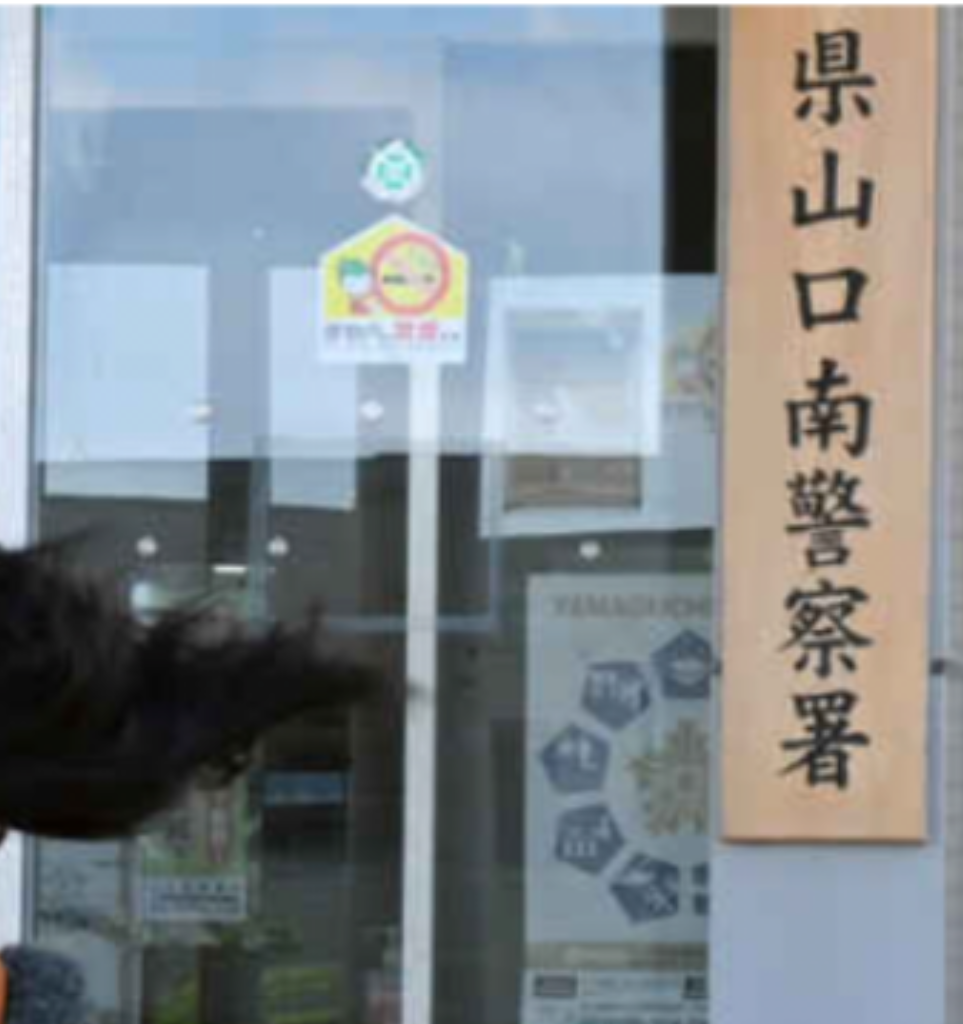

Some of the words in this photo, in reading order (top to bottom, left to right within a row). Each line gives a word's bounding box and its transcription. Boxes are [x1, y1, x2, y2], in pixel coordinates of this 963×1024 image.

[780, 28, 876, 792] 県山口南警察署
